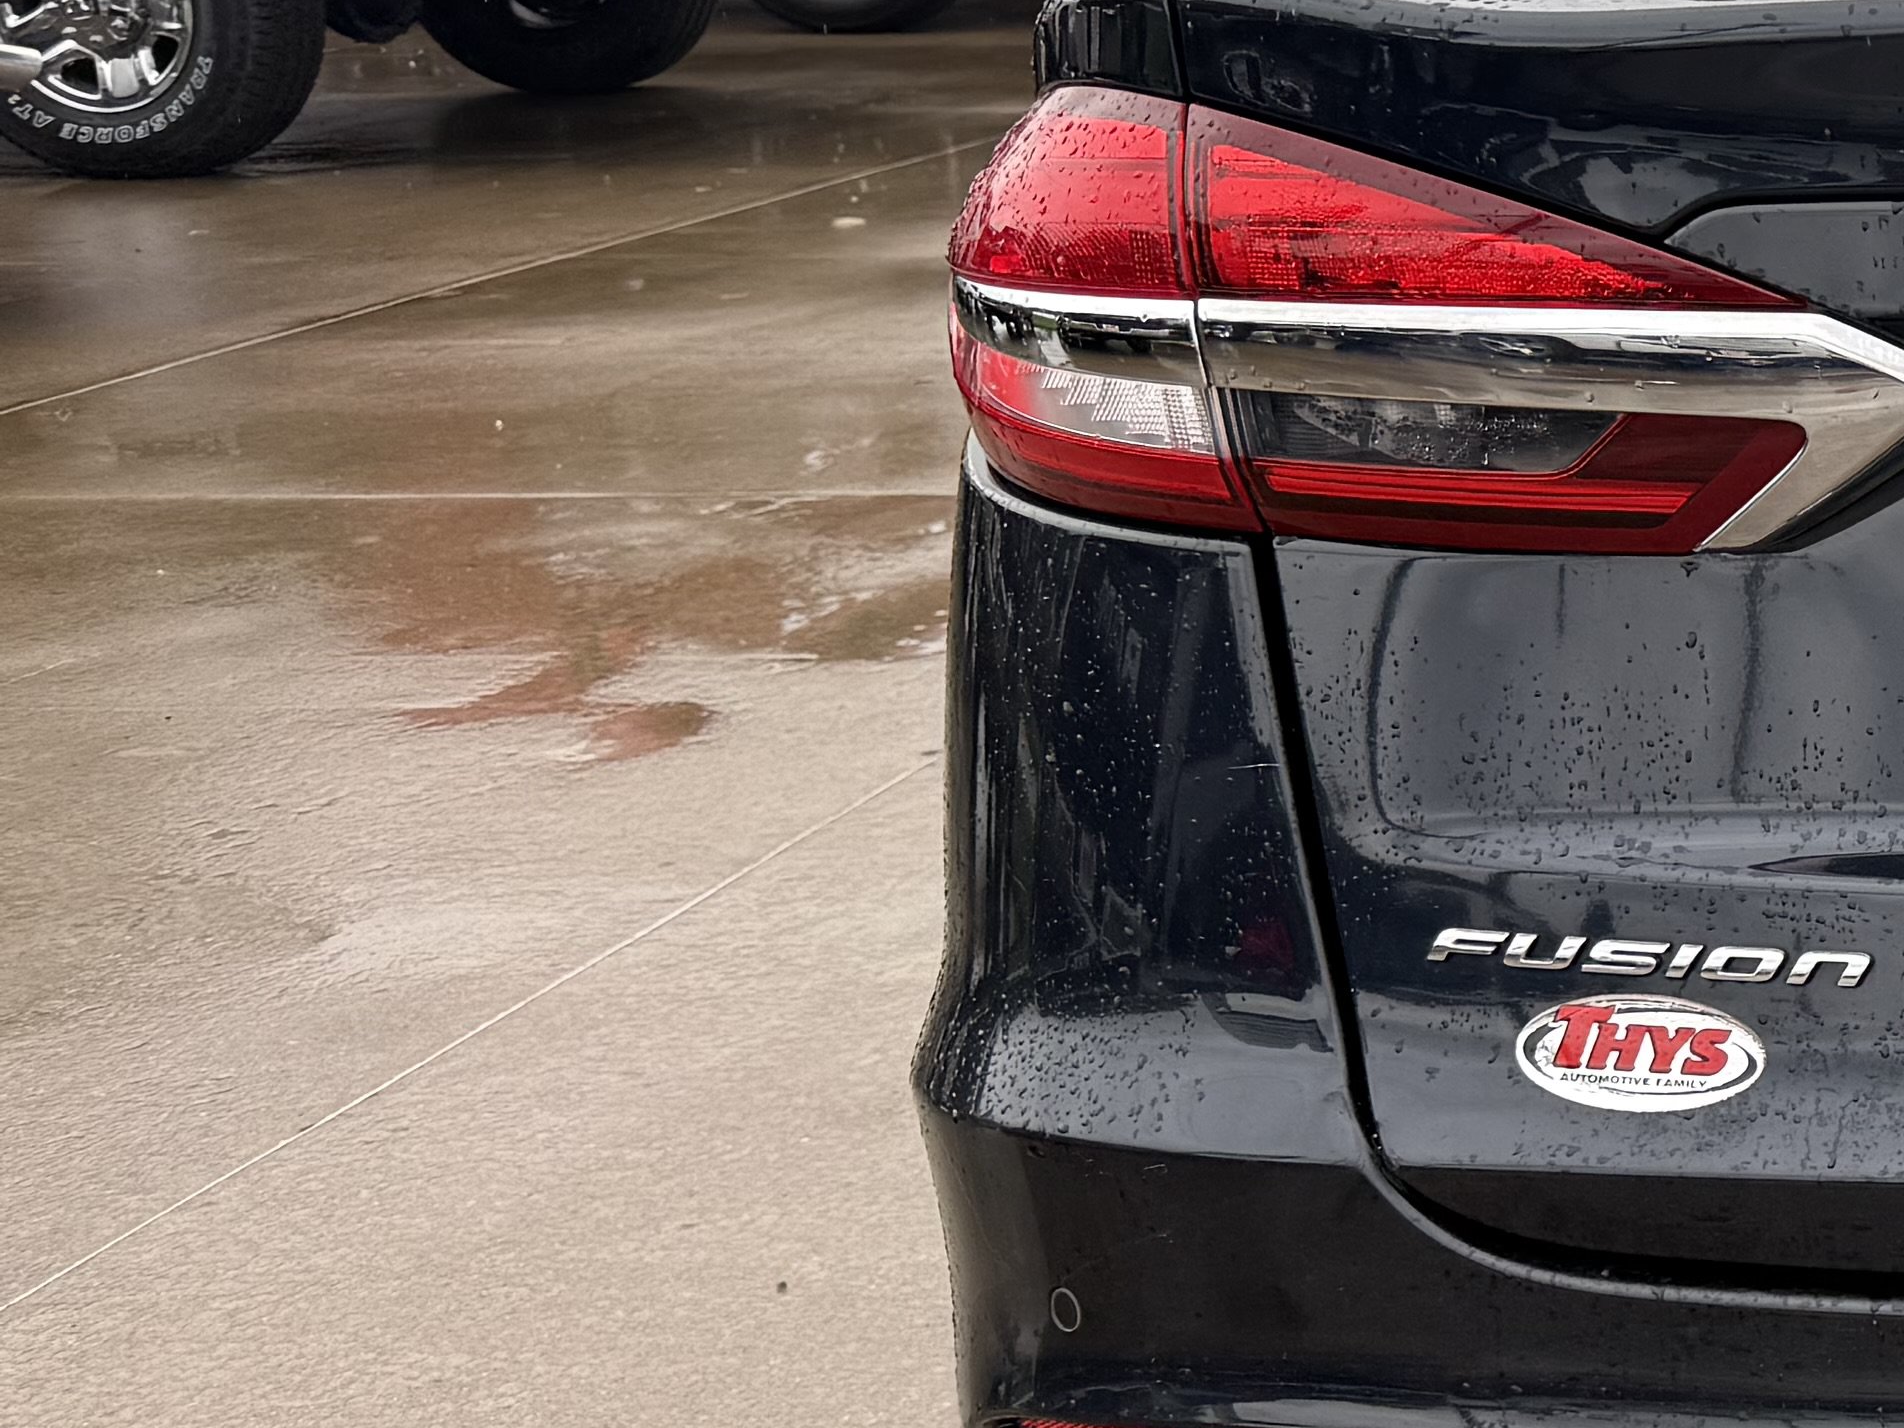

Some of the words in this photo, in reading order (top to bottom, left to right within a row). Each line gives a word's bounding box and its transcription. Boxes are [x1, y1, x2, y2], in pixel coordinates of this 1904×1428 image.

[1426, 927, 1874, 987] FUSION
[1552, 1004, 1732, 1076] THYS
[1560, 1073, 1650, 1086] AUTOMOTIVE
[1656, 1077, 1708, 1089] FAMILY
